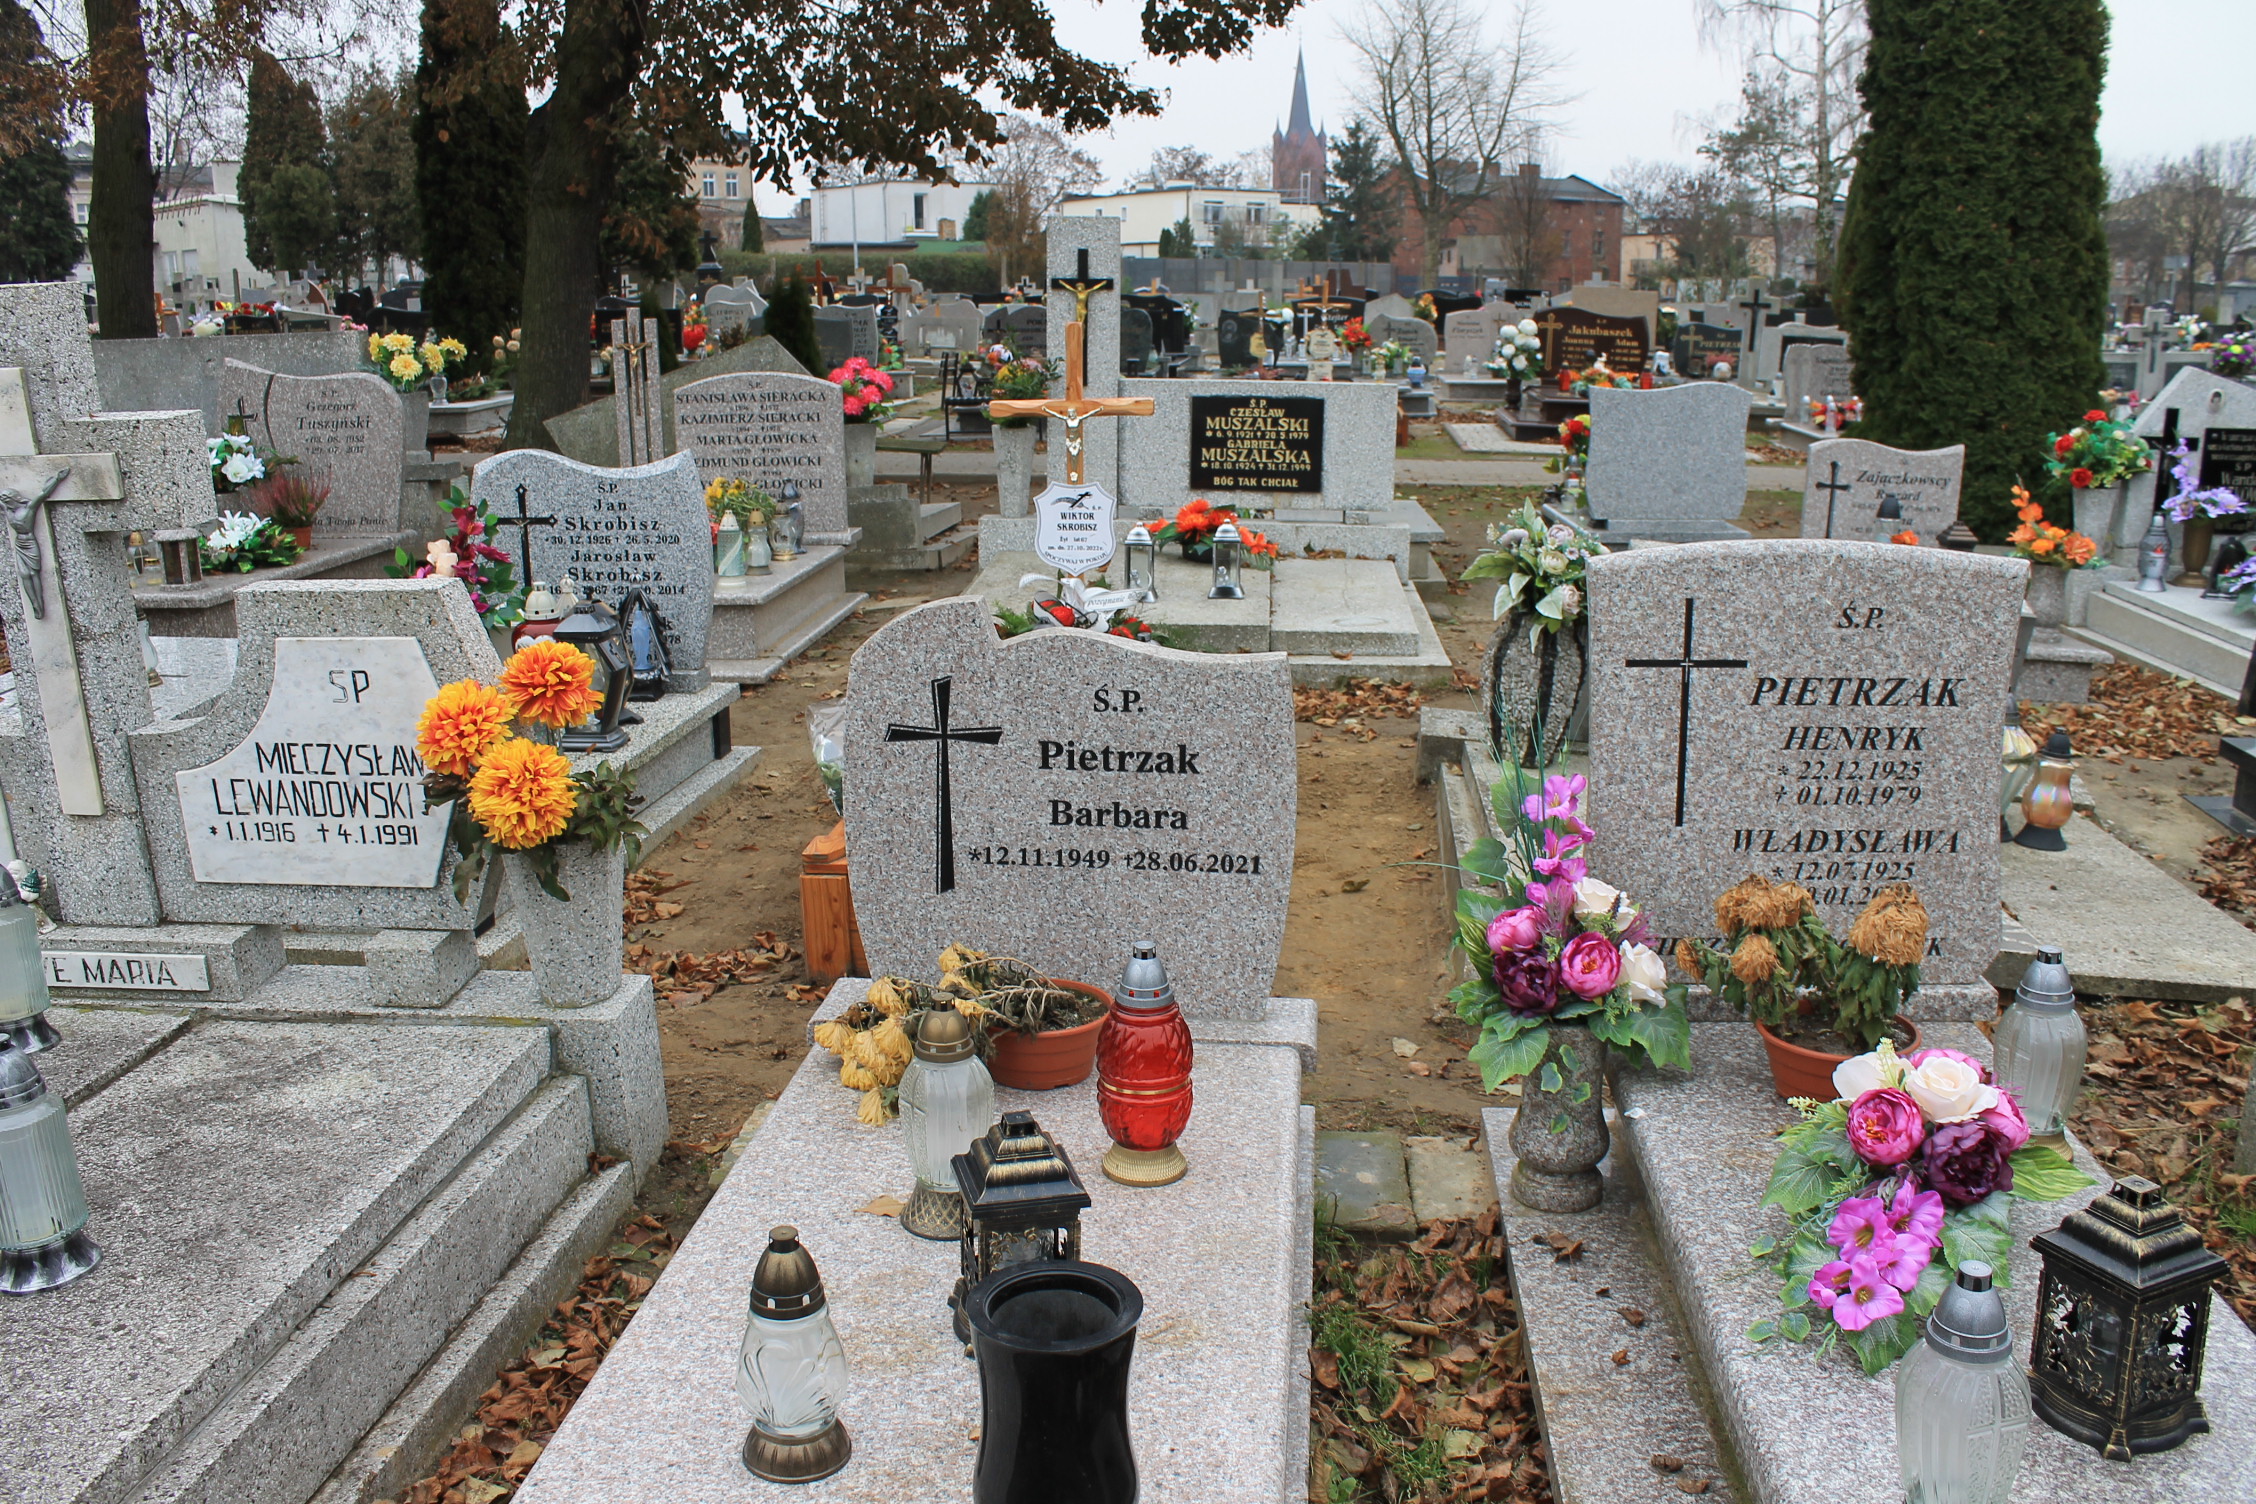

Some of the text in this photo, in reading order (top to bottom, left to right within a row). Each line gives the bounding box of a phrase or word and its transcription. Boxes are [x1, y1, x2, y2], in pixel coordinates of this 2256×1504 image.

[1568, 325, 1633, 337] Jakubaszek
[760, 391, 826, 402] SIERACKA
[306, 402, 356, 413] Grzegorz
[1230, 407, 1285, 418] CZESŁAW
[297, 415, 370, 432] Tuszyński
[681, 412, 821, 425] KAZIMIERZ SIERACKI
[1206, 416, 1309, 431] MUSZALSKI
[696, 435, 742, 446] MARTA
[1227, 439, 1286, 450] GABRIELA
[1201, 447, 1311, 463] MUSZALSKA
[1213, 475, 1299, 488] BÓG TAK CHCIAŁ
[1856, 470, 1951, 489] Zajączkowscy
[1875, 489, 1921, 501] Rzard
[593, 499, 627, 511] Jan
[565, 516, 660, 531] Skrobisz
[1060, 512, 1095, 520] WIKTOR
[1056, 523, 1097, 531] SKROBISZ
[571, 550, 657, 562] Jarosław
[658, 585, 685, 595] 2014
[1838, 601, 1884, 629] Ś.P.
[1093, 684, 1144, 713] Ś.P.
[1750, 677, 1966, 707] PIETRZAK
[1781, 726, 1927, 751] HENRYK
[255, 741, 425, 778] MIECZYSŁAW
[1038, 740, 1200, 775] Pietrzak
[212, 778, 414, 819] LEWANDOWSKI
[1050, 799, 1189, 830] Barbara
[1733, 829, 1960, 853] WŁADYSŁAWA
[82, 957, 178, 987] MARIA
